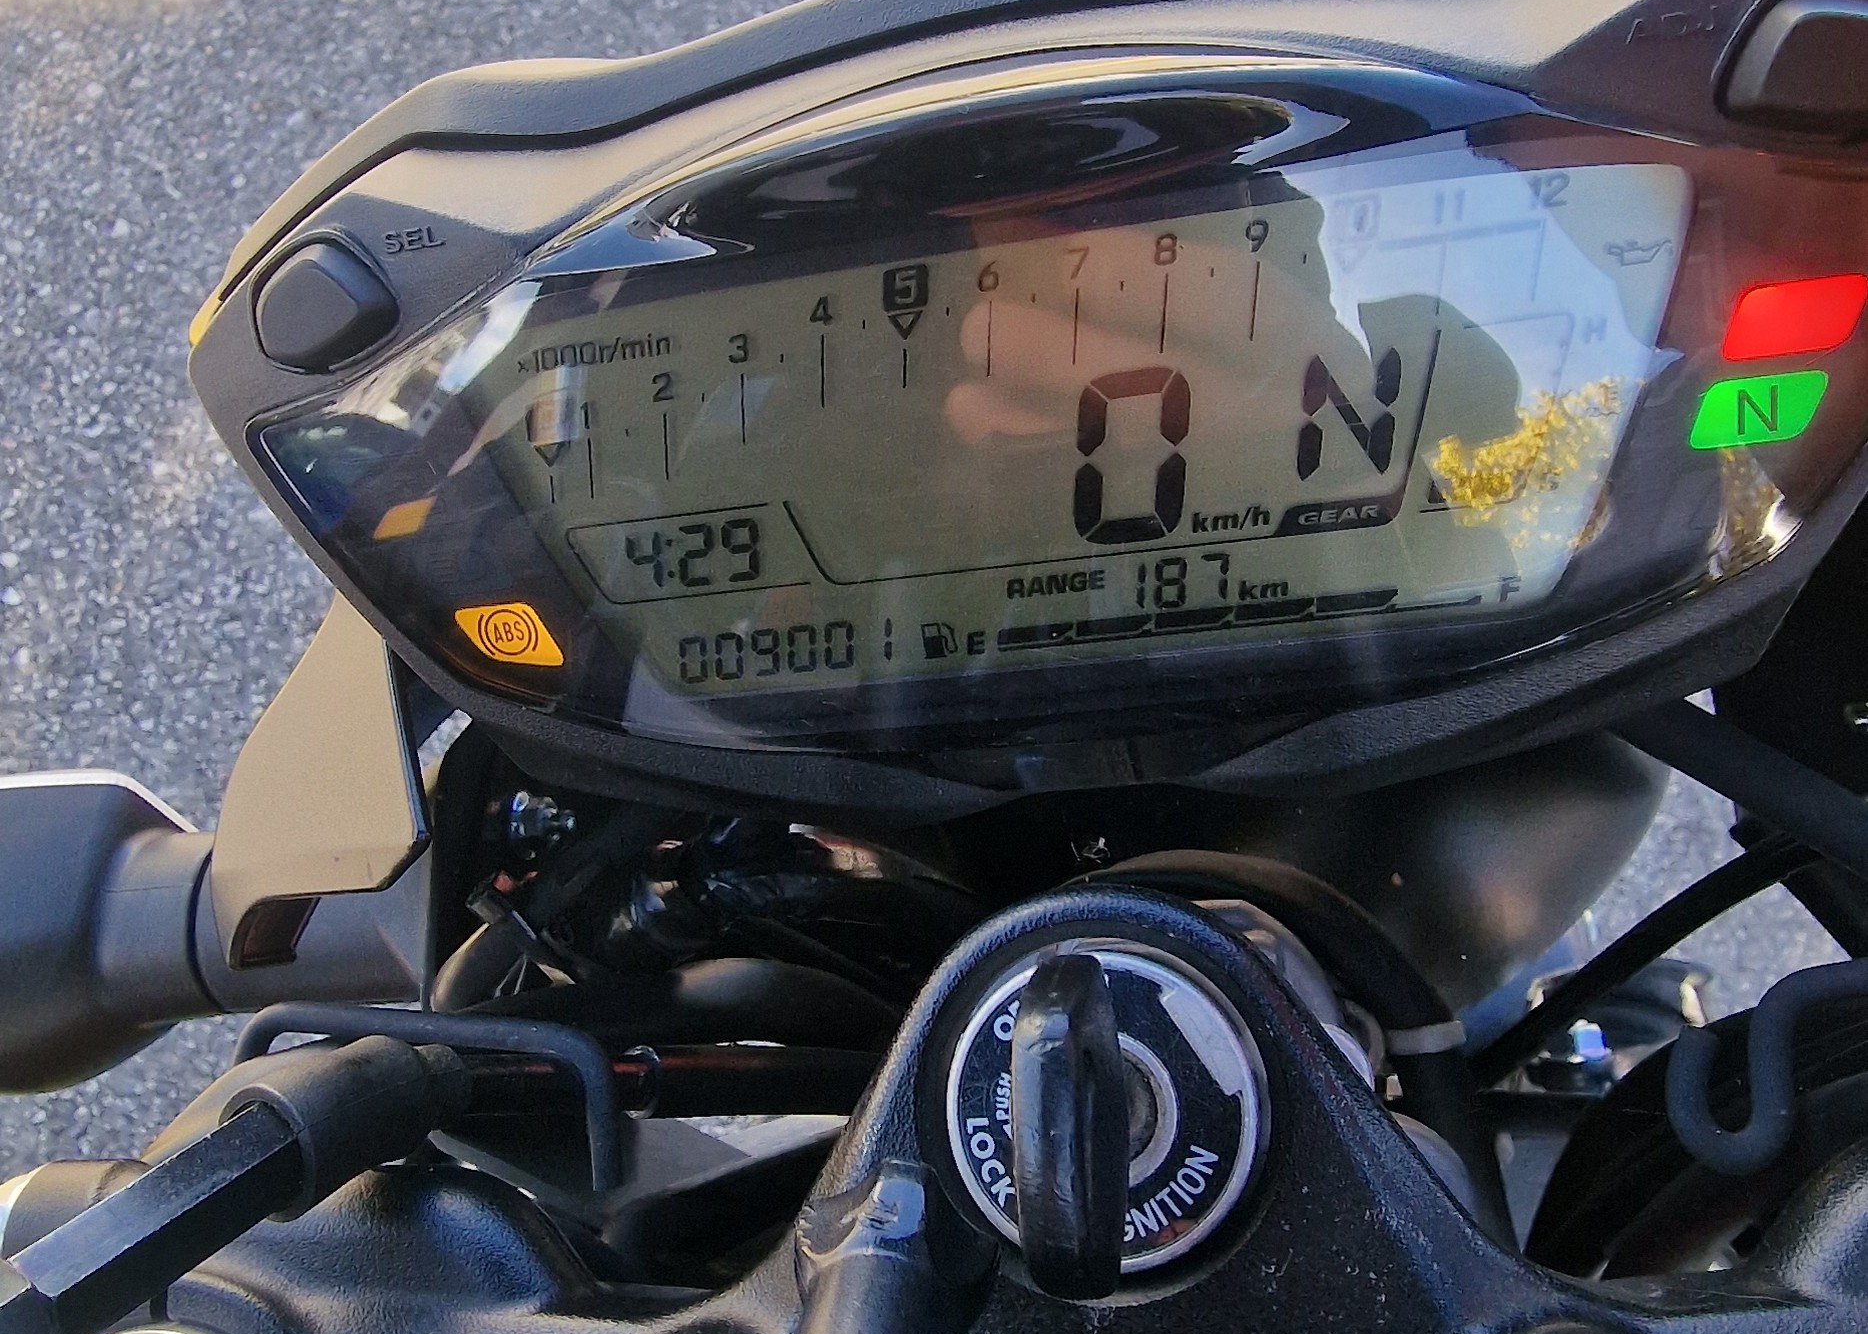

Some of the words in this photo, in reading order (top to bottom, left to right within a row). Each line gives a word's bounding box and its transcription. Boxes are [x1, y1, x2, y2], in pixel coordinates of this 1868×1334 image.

[1528, 171, 1572, 208] 12
[383, 225, 446, 255] SEL
[1154, 233, 1178, 266] 8
[1245, 219, 1269, 254] 9
[978, 262, 1000, 293] 6
[1067, 247, 1090, 279] 7
[809, 296, 834, 326] 4
[728, 333, 750, 365] 3
[651, 371, 675, 403] 2
[580, 400, 592, 430] 1
[1297, 347, 1401, 481] N
[1736, 383, 1778, 435] N
[1074, 367, 1192, 545] 0
[1192, 506, 1271, 534] km/h
[1298, 503, 1380, 526] GEAR
[625, 519, 761, 588] 4:29
[1006, 568, 1106, 599] RANGE
[1136, 553, 1230, 609] 187
[1238, 578, 1290, 602] km
[493, 621, 526, 644] ABS
[967, 630, 986, 656] E
[678, 619, 893, 685] 009001
[995, 1072, 1012, 1121] PUSH
[966, 1117, 1016, 1208] LOCK
[1123, 1144, 1220, 1243] GNITION
